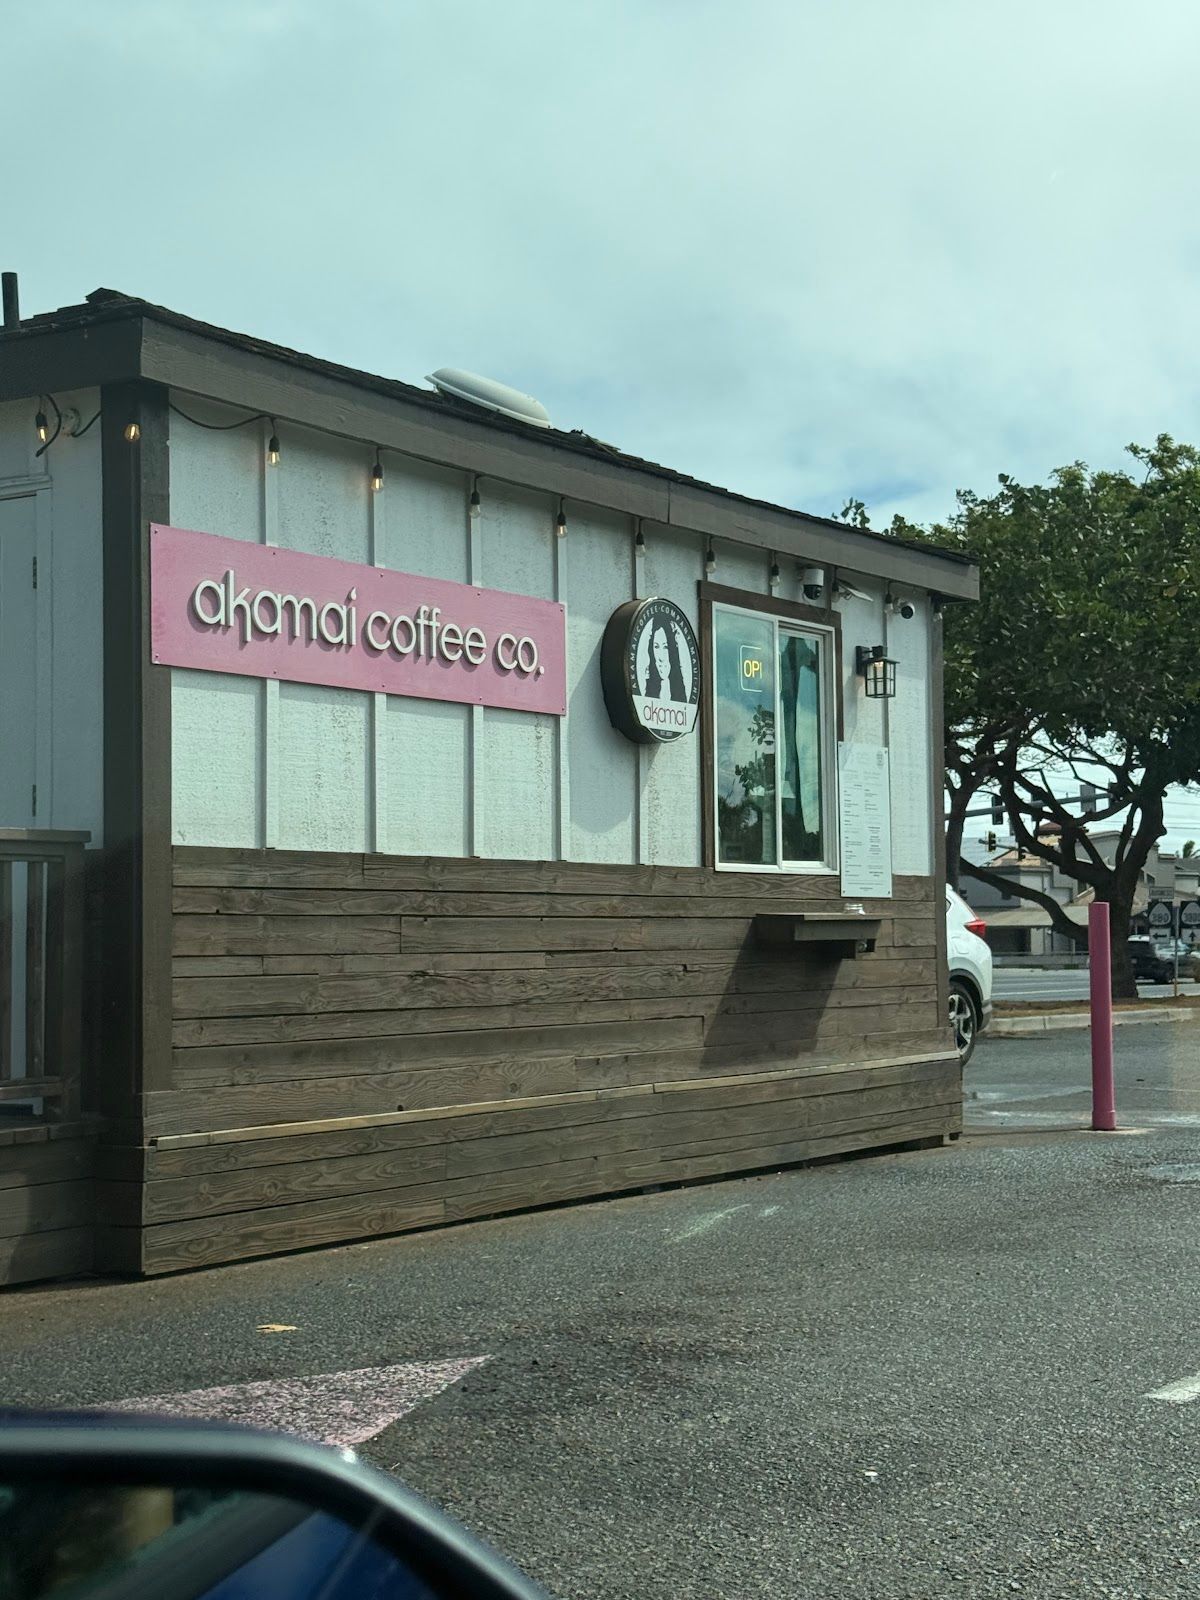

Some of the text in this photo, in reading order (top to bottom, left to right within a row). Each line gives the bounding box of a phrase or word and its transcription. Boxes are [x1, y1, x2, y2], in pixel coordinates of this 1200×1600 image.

[194, 569, 545, 675] akamai coffee co.
[630, 637, 638, 689] AKAMAI
[636, 605, 658, 633] COFFEE
[660, 605, 692, 641] COMPANY
[643, 700, 687, 726] akamai
